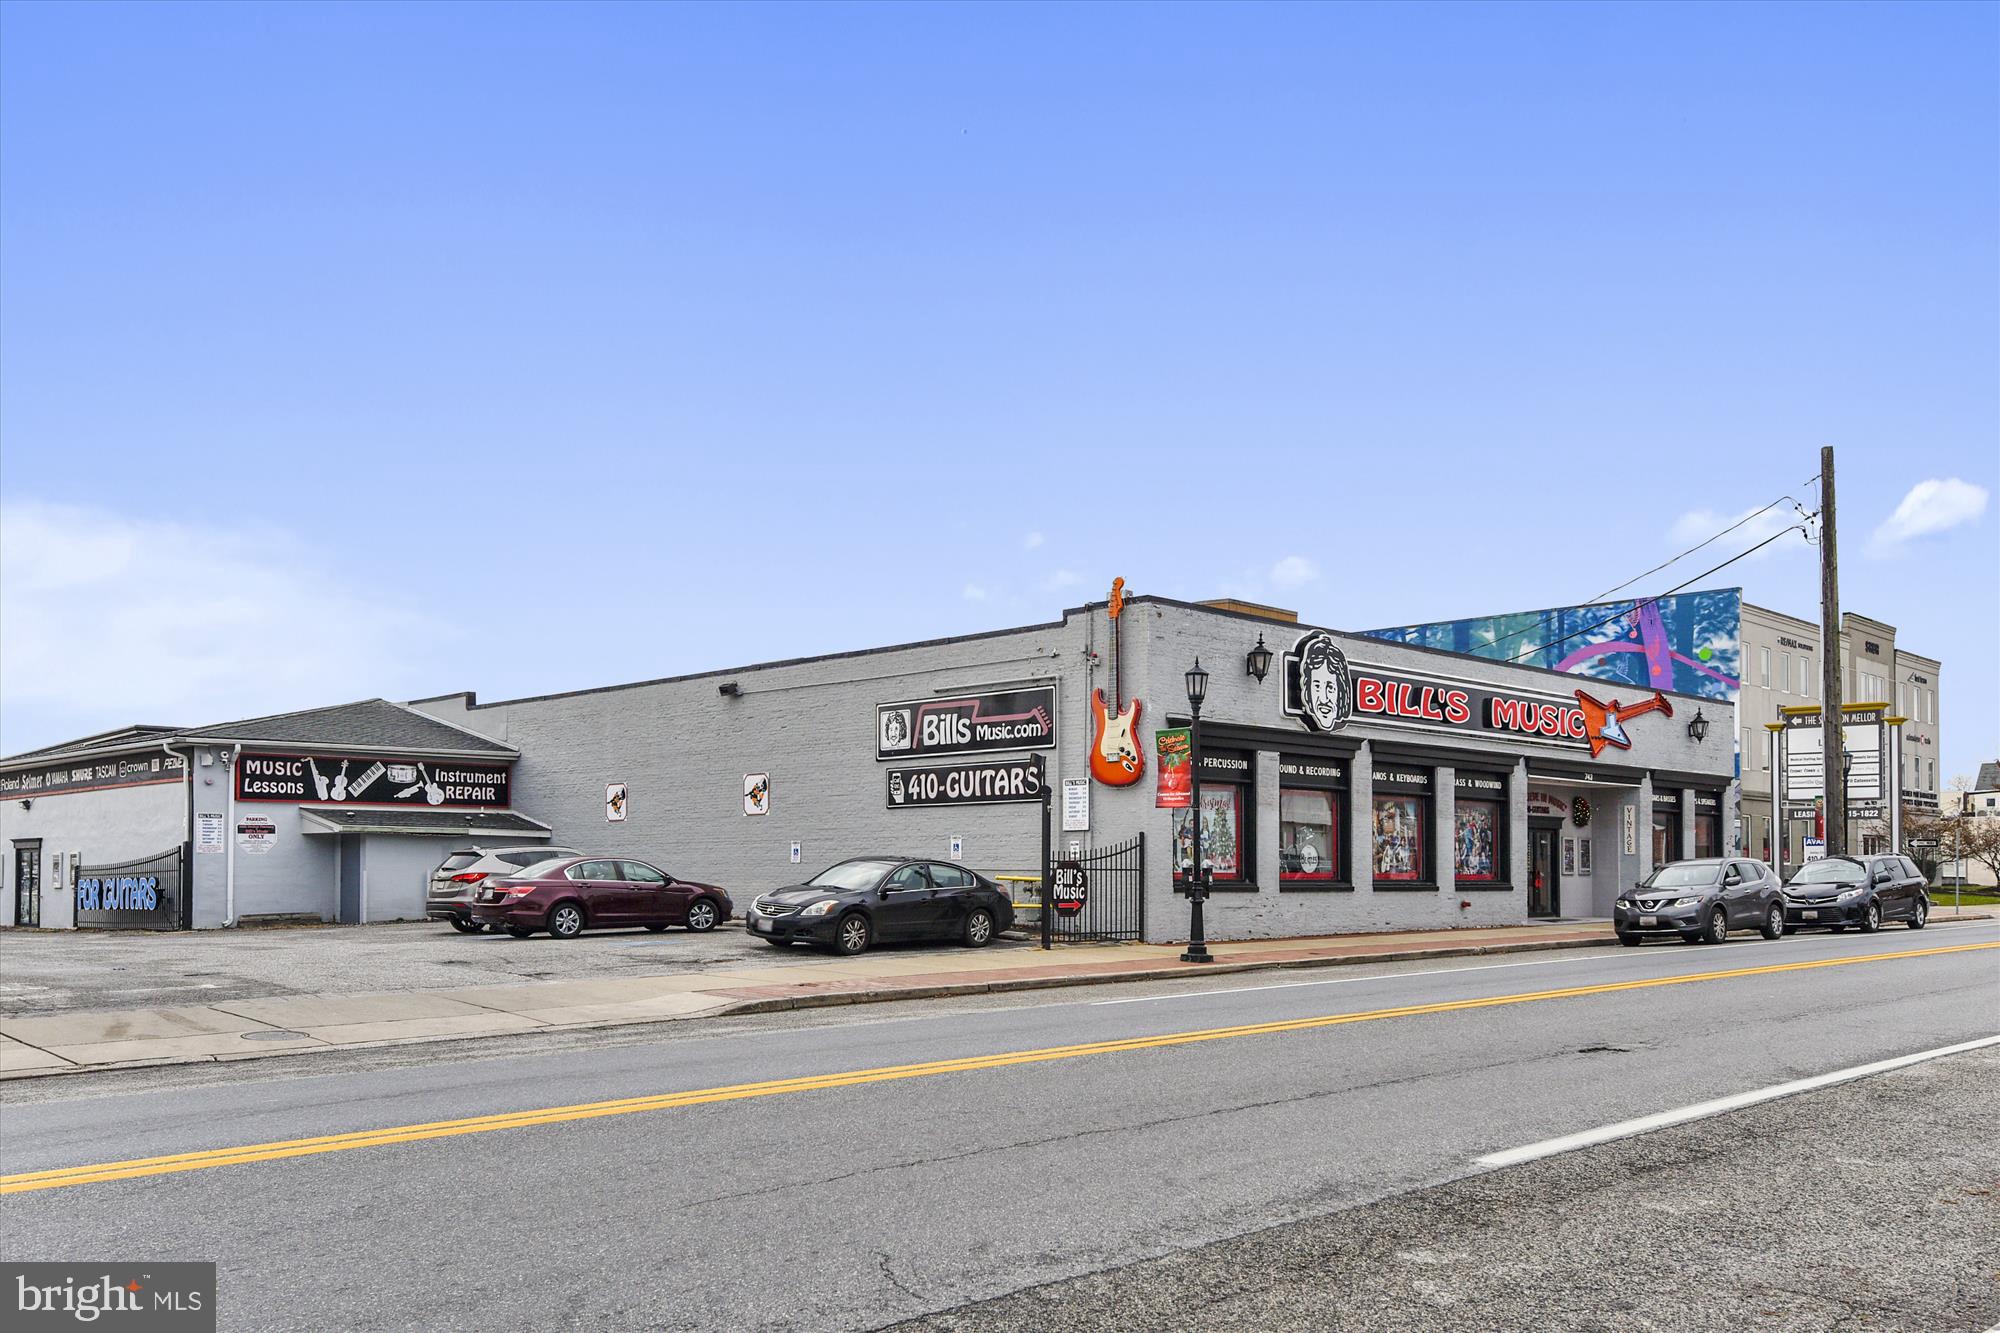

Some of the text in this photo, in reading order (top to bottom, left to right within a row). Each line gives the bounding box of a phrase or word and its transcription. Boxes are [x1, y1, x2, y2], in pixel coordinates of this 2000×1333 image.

[1356, 677, 1586, 738] BILL'S MUSIC
[1804, 715, 1817, 725] THE
[1851, 712, 1876, 723] MELLOR
[923, 713, 1042, 746] Bills Music.com
[127, 762, 149, 773] crown
[246, 760, 303, 777] MUSIC
[1203, 757, 1248, 770] PERCUSSION
[1279, 763, 1341, 777] OUND & RECORDING
[51, 770, 69, 785] YAMAHA
[95, 764, 117, 779] TASCAM
[435, 768, 506, 785] Instrument
[1372, 771, 1428, 784] ANOS & KEYBOARDS
[244, 778, 304, 795] Lessons
[908, 766, 1040, 800] 410-GUITARS
[1455, 778, 1502, 790] ASS & WOODWIND
[445, 786, 496, 800] REPAIR
[1793, 809, 1879, 818] LEASI 15-1822
[1055, 868, 1083, 885] Bill's
[77, 877, 157, 911] FOR GUITARS
[1053, 884, 1086, 899] Music
